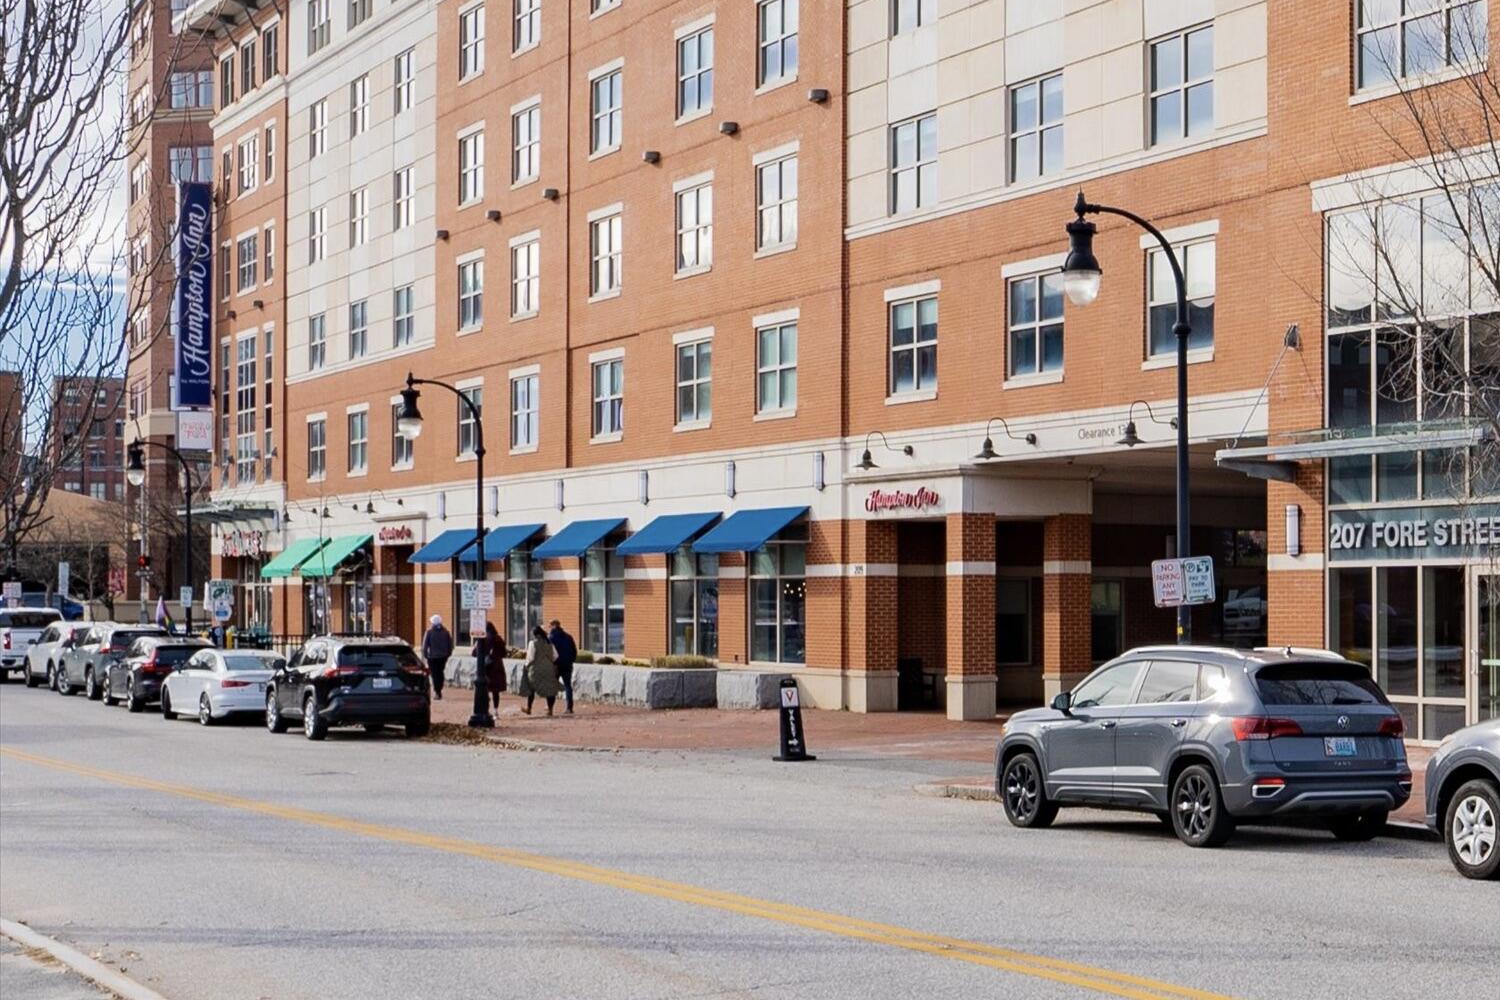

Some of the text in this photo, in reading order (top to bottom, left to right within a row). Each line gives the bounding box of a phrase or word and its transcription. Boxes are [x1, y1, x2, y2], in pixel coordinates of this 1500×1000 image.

[182, 203, 209, 376] Hampton Inn
[1078, 427, 1116, 440] Clearance
[865, 486, 939, 512] Hampton Inn
[1329, 522, 1366, 549] 207
[1371, 520, 1428, 548] FORE
